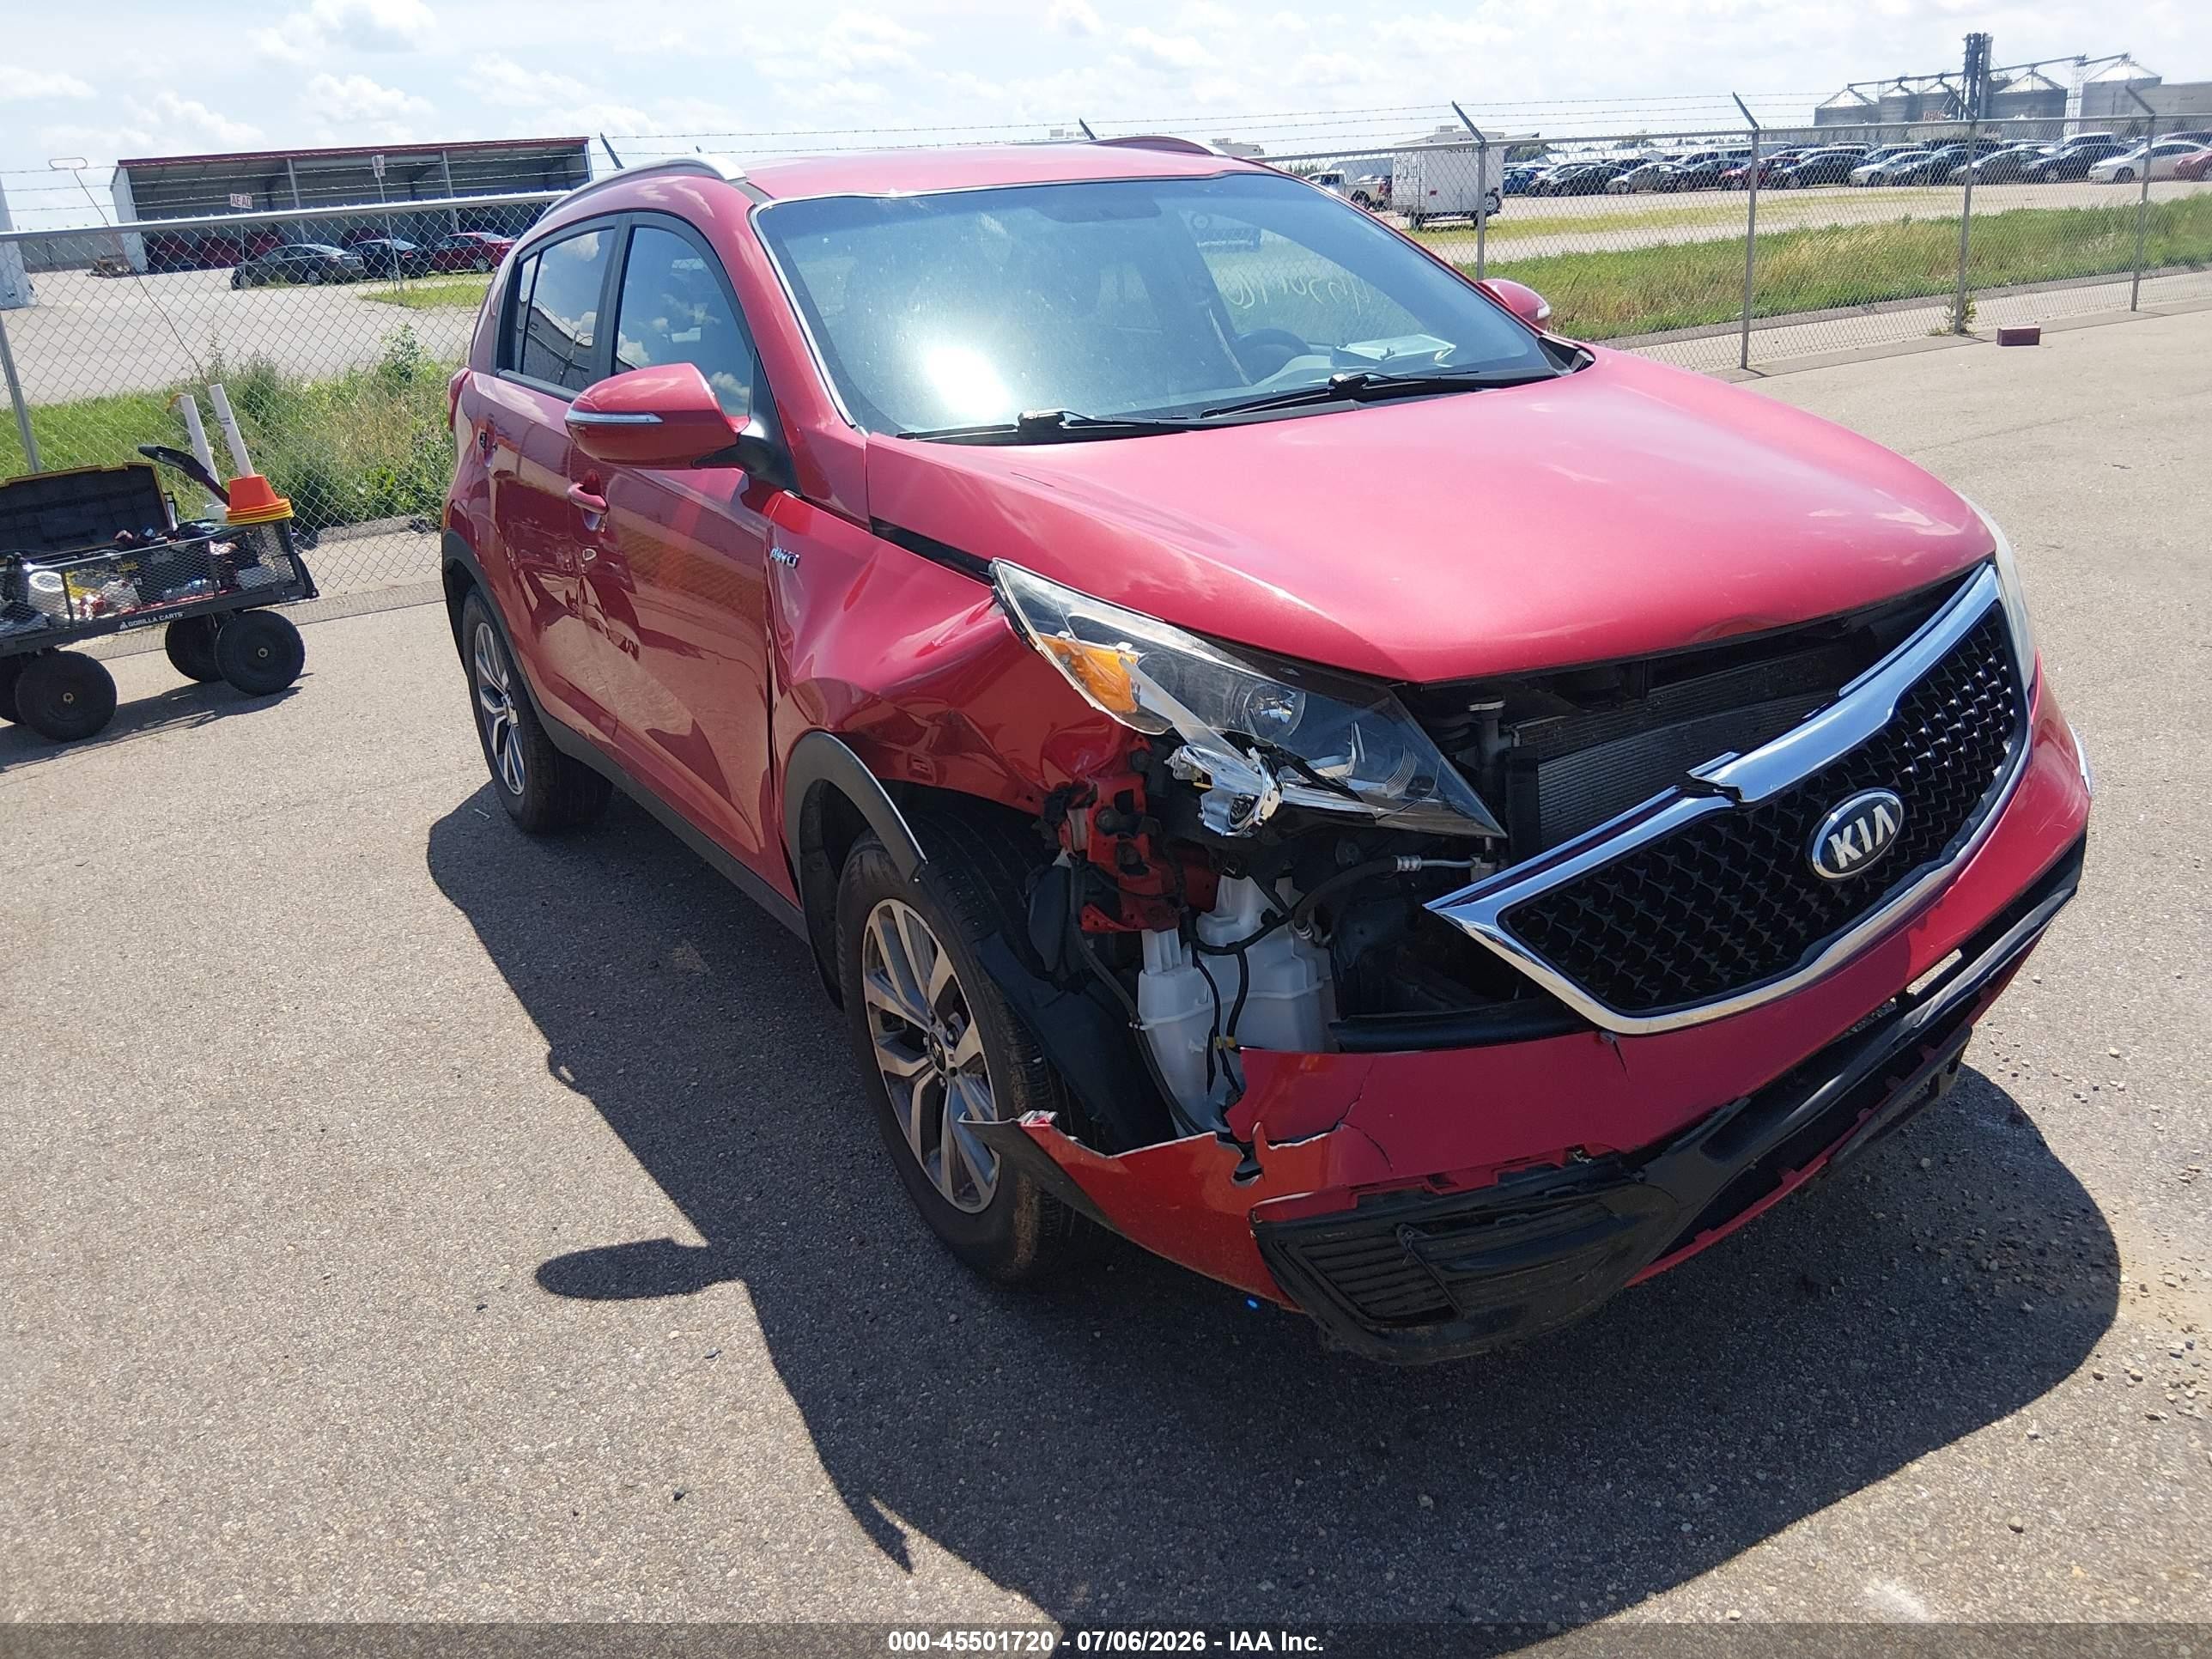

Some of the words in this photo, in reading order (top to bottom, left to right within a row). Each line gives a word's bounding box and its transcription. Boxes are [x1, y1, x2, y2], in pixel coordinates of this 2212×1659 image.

[128, 617, 158, 627] GORILLA
[158, 611, 184, 622] CARTS
[1827, 804, 1896, 869] KIA
